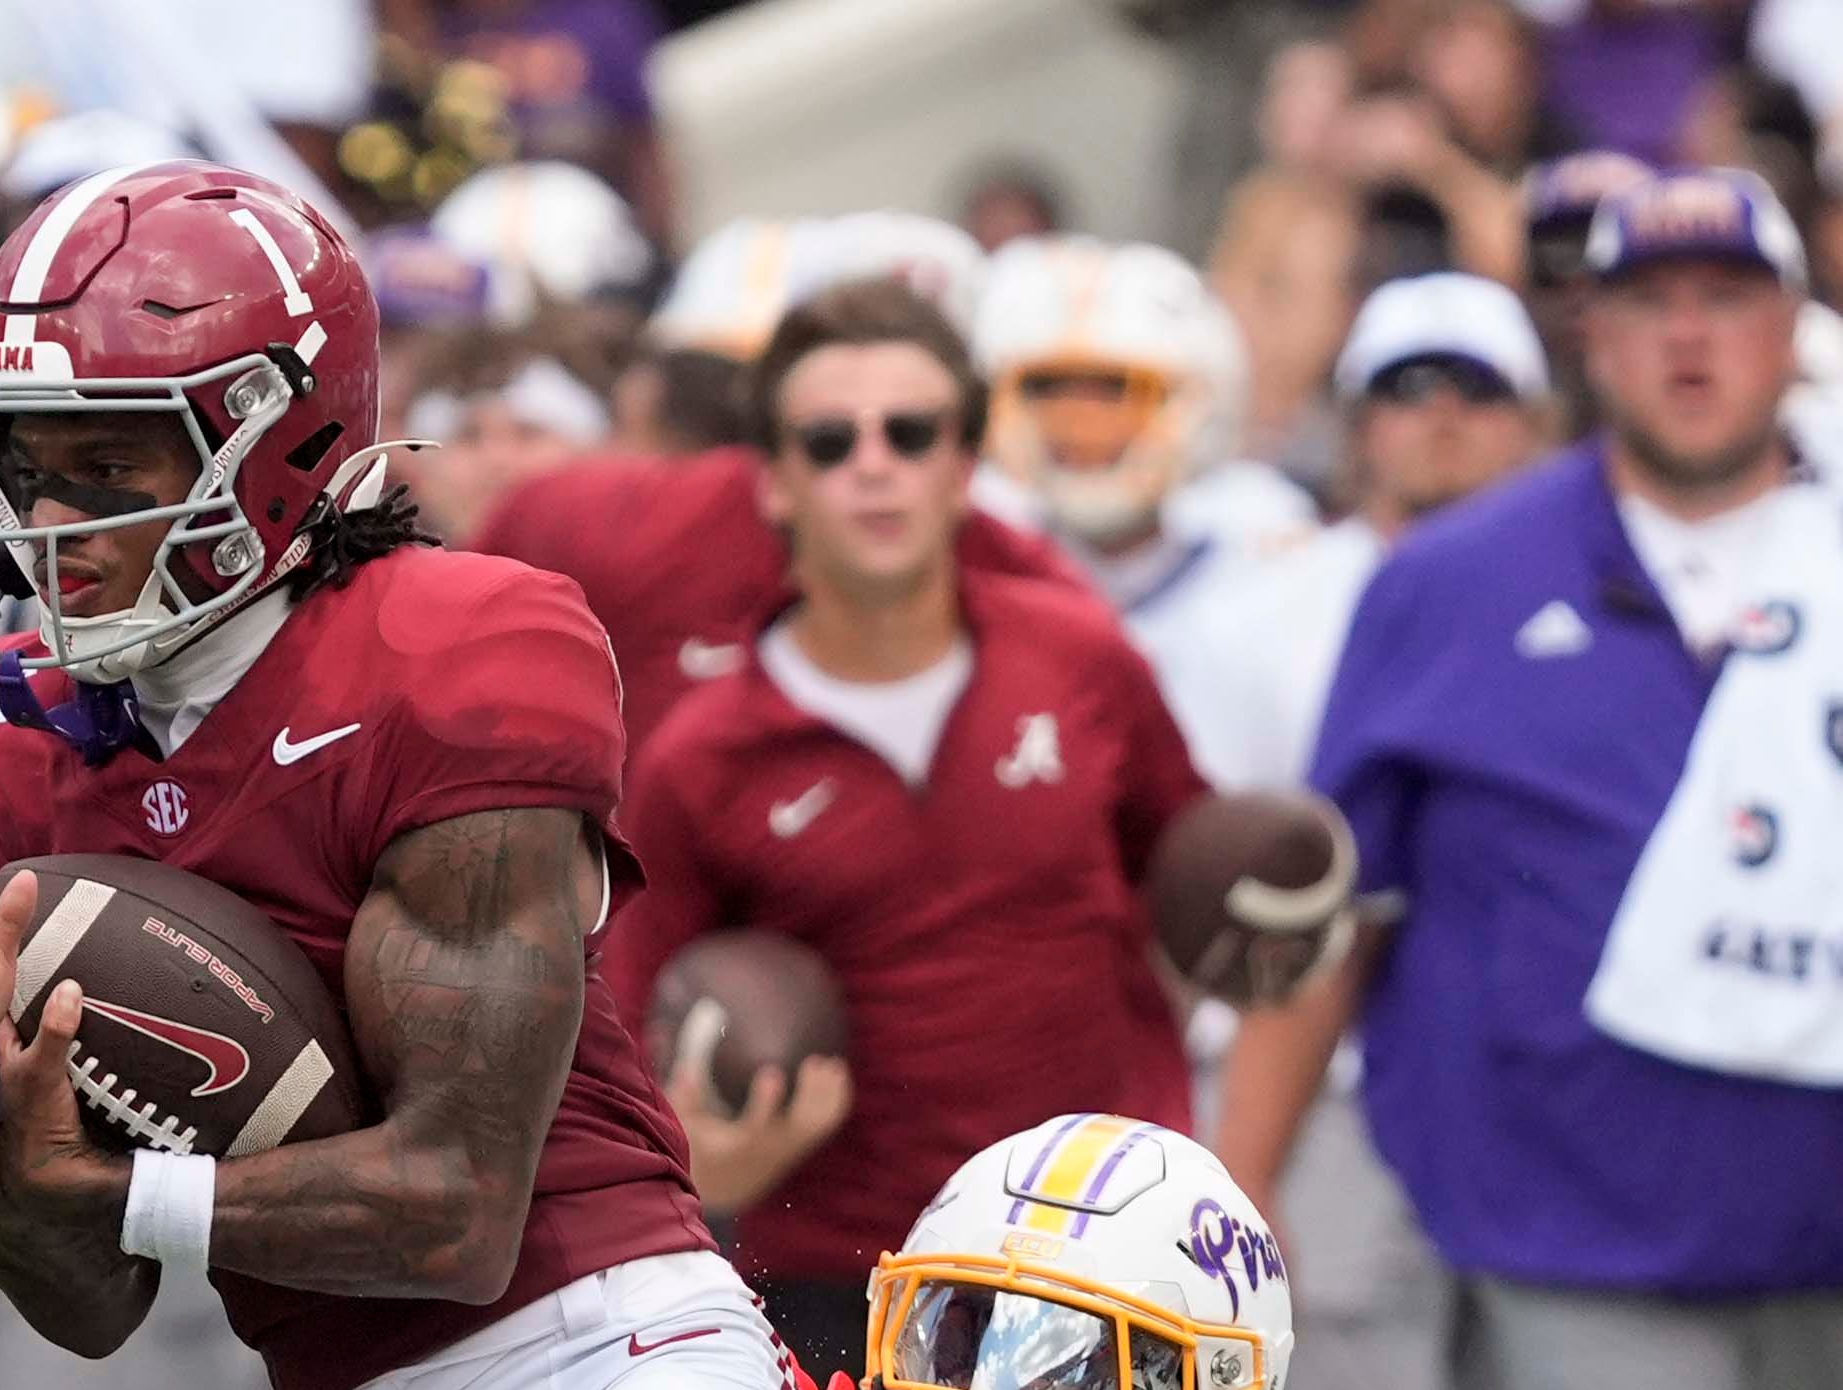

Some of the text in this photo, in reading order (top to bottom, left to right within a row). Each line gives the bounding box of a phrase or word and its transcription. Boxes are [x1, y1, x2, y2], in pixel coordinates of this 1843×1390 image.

[228, 208, 314, 317] 1
[141, 781, 189, 835] SEC
[141, 915, 275, 1025] VAPOR ELITE
